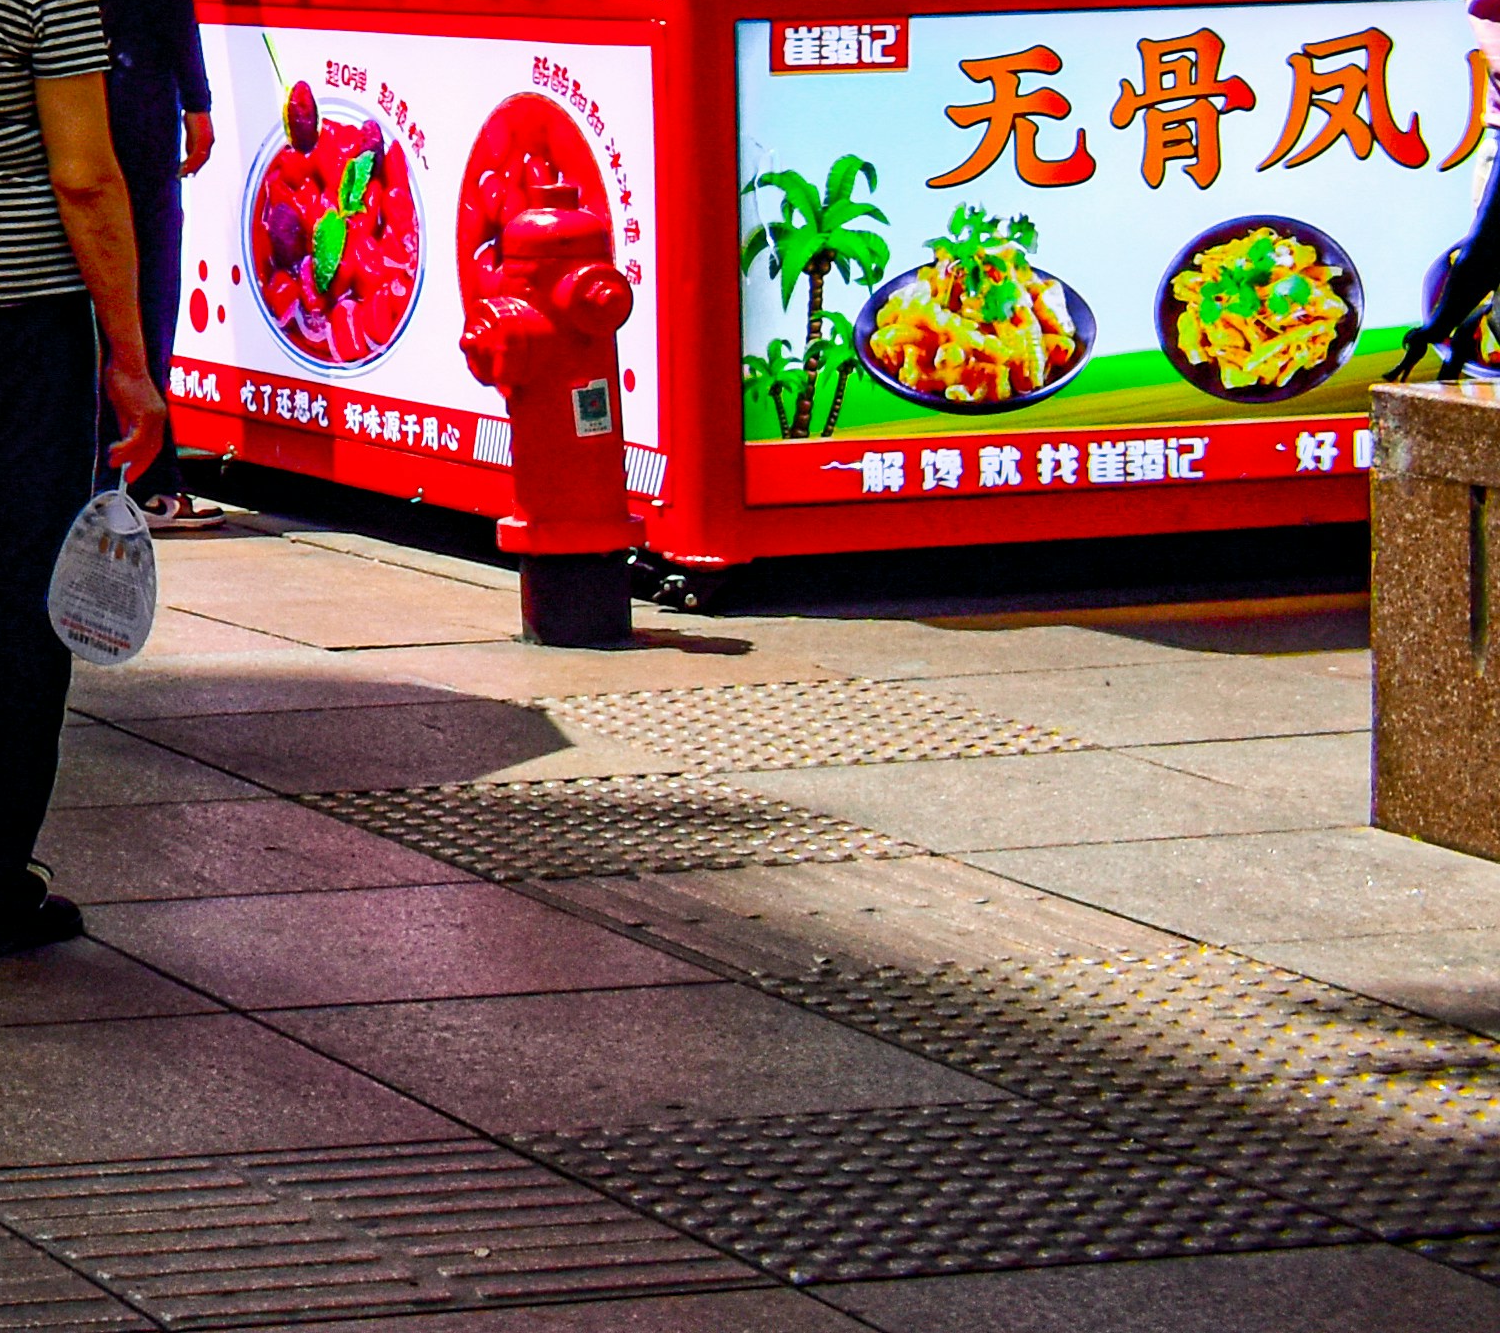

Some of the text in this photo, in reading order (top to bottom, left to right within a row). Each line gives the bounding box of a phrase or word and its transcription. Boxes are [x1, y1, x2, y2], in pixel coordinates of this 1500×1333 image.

[240, 380, 329, 428] 吃了还想吃
[343, 402, 461, 452] 好味源于用心
